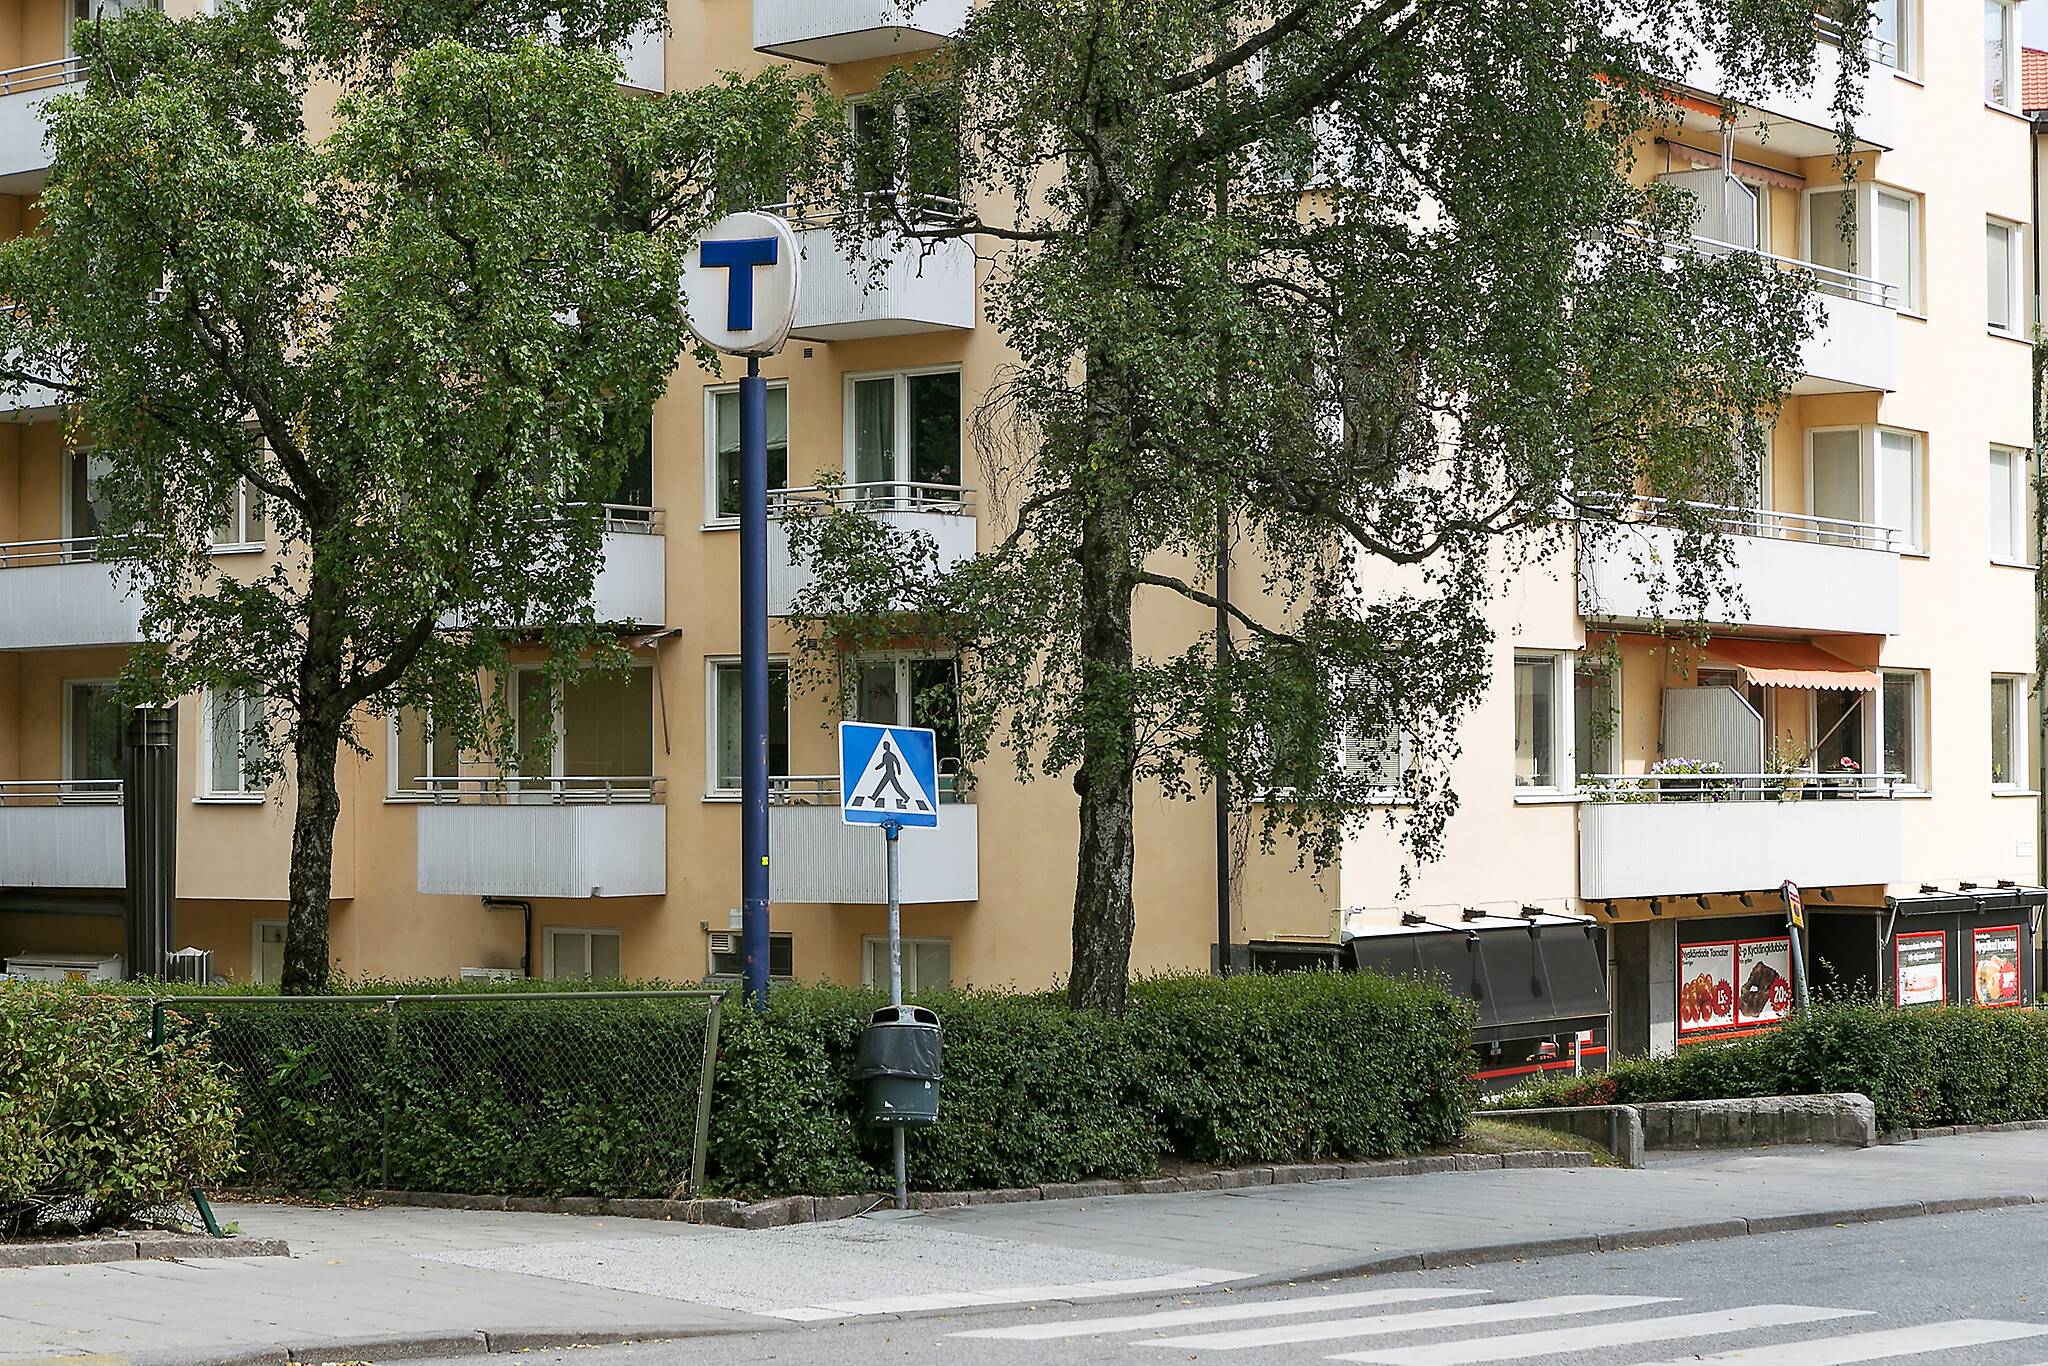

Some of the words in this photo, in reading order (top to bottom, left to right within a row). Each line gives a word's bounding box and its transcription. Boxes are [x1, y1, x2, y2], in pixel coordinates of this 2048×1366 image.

[700, 237, 778, 331] T
[1710, 948, 1729, 957] Tomater
[1748, 942, 1788, 956] Kycklingklubbor
